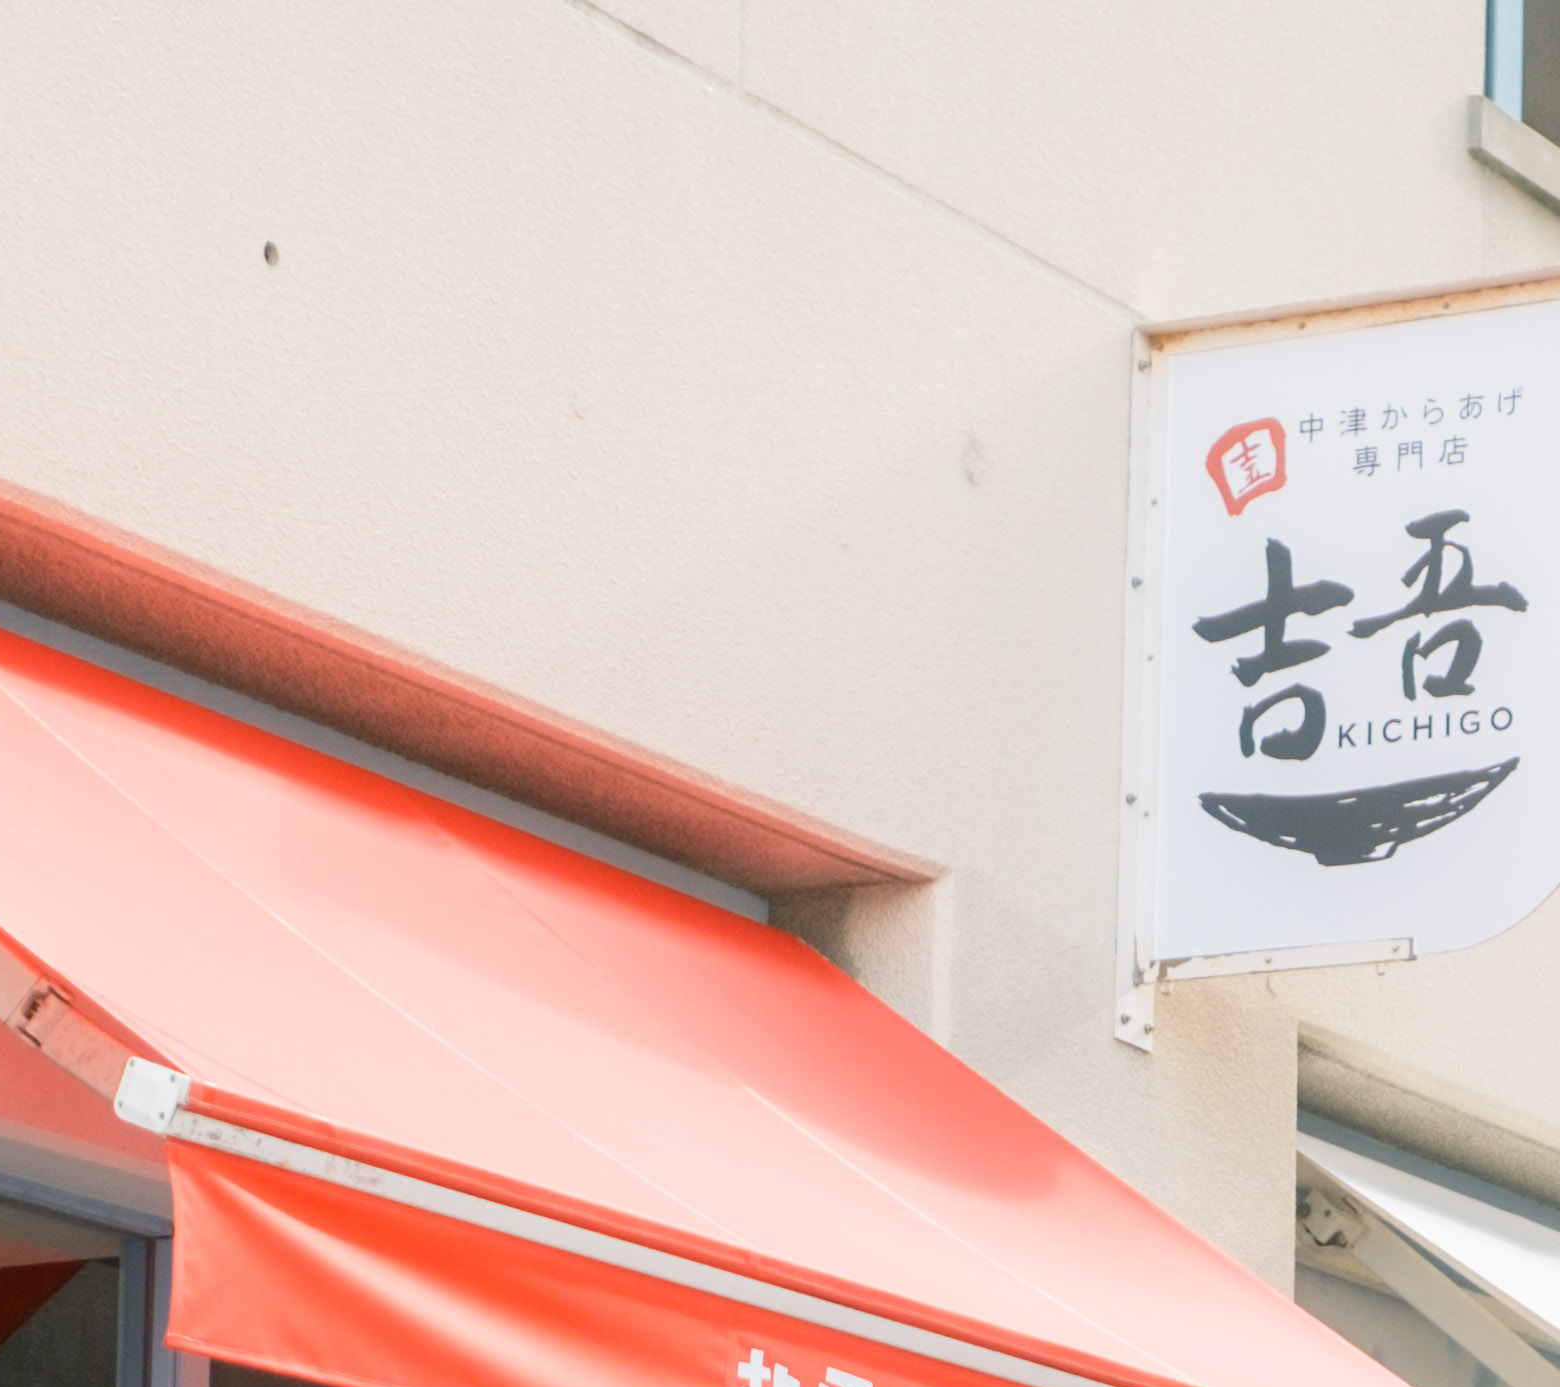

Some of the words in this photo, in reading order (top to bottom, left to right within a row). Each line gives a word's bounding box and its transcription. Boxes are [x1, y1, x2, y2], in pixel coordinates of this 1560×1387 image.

[1298, 387, 1524, 443] 中津からあげ
[1352, 436, 1470, 477] 専門店
[1337, 705, 1515, 750] KICHIGO
